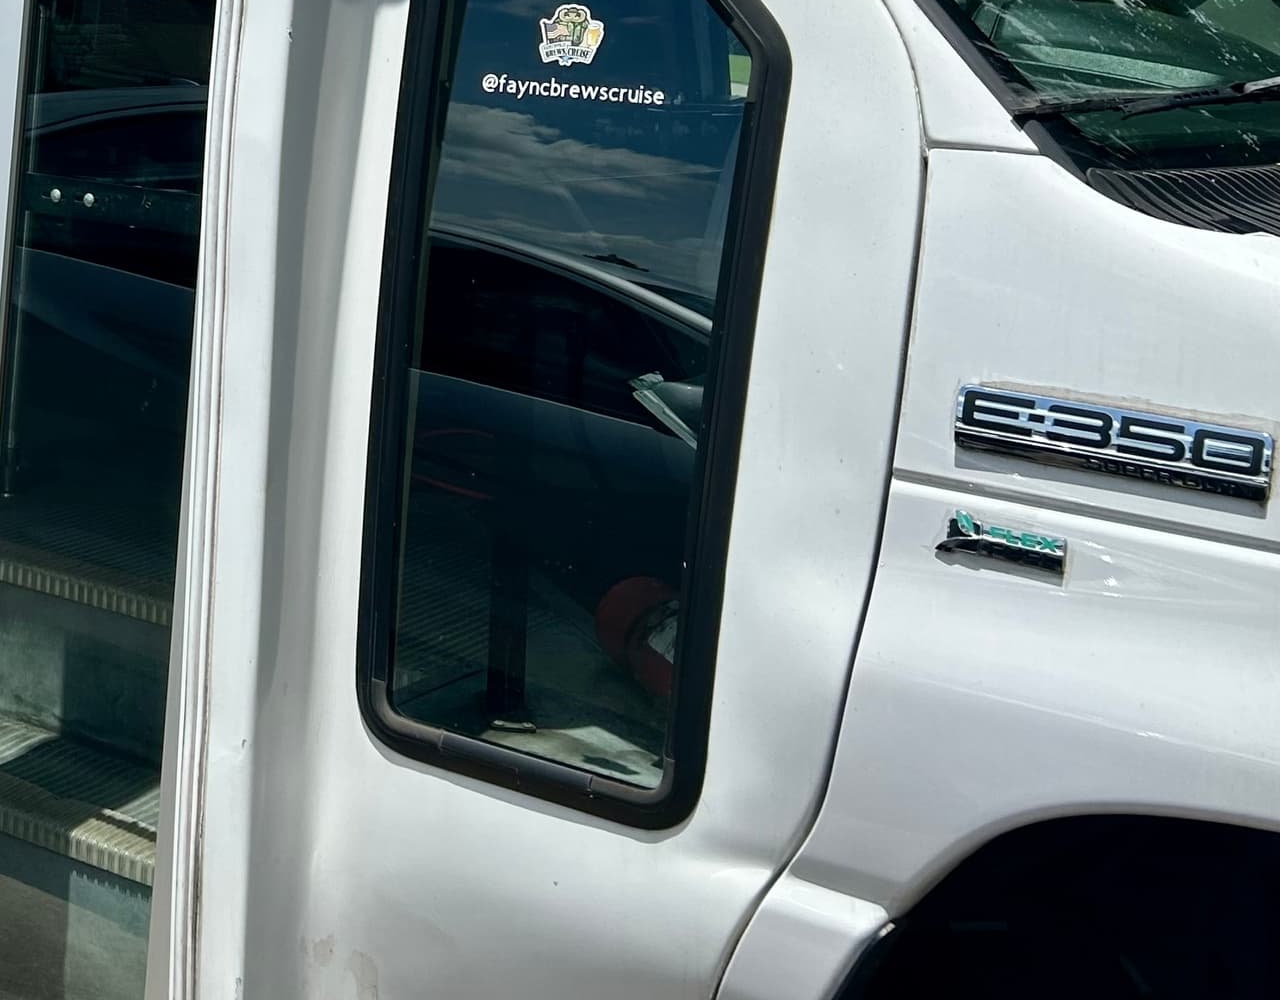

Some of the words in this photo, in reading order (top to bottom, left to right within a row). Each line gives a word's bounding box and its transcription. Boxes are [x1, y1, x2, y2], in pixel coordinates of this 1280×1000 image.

[482, 73, 665, 105] @fayncbrewscruise
[962, 389, 1266, 477] E-350
[987, 525, 1062, 554] FLEX
